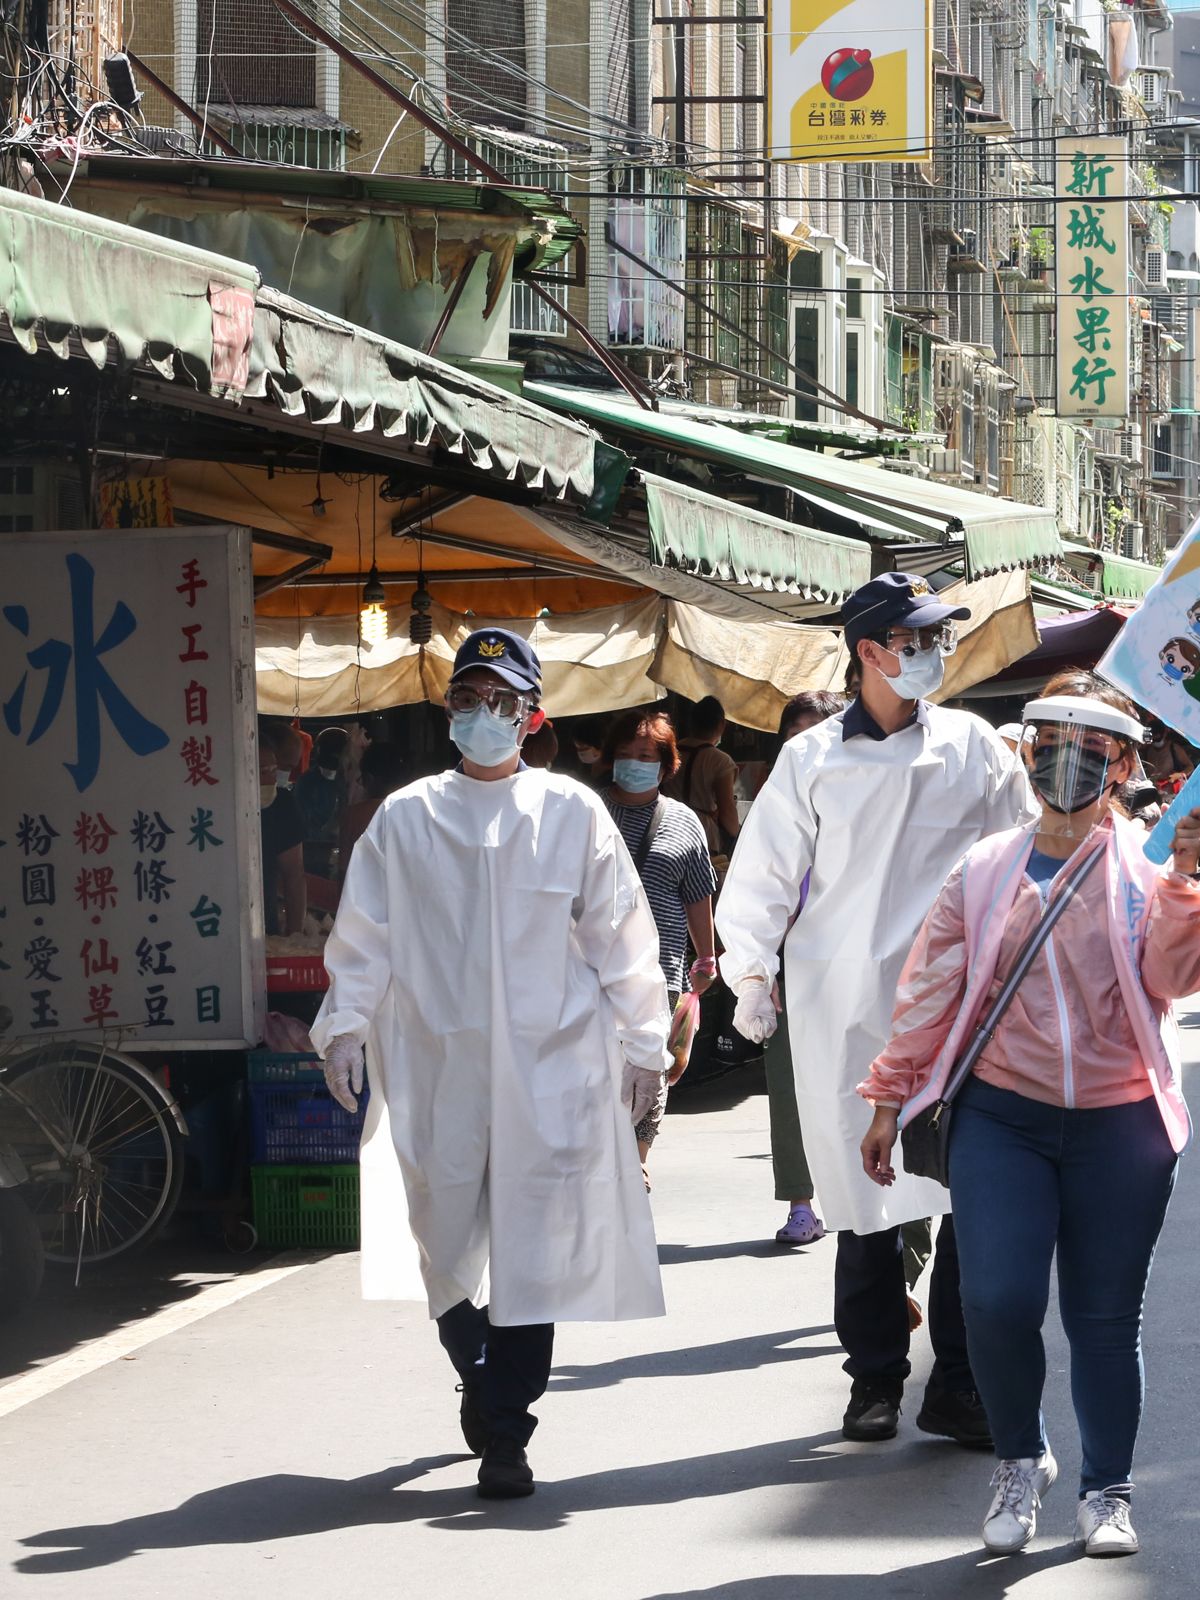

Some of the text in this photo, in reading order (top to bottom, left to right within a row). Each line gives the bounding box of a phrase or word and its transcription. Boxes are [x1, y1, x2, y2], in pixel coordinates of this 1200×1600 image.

[808, 109, 887, 127] 台灣彩券
[1065, 150, 1117, 405] 新城水果行
[2, 552, 171, 794] 冰
[176, 558, 220, 787] 手工自製
[186, 807, 224, 1024] 米台目
